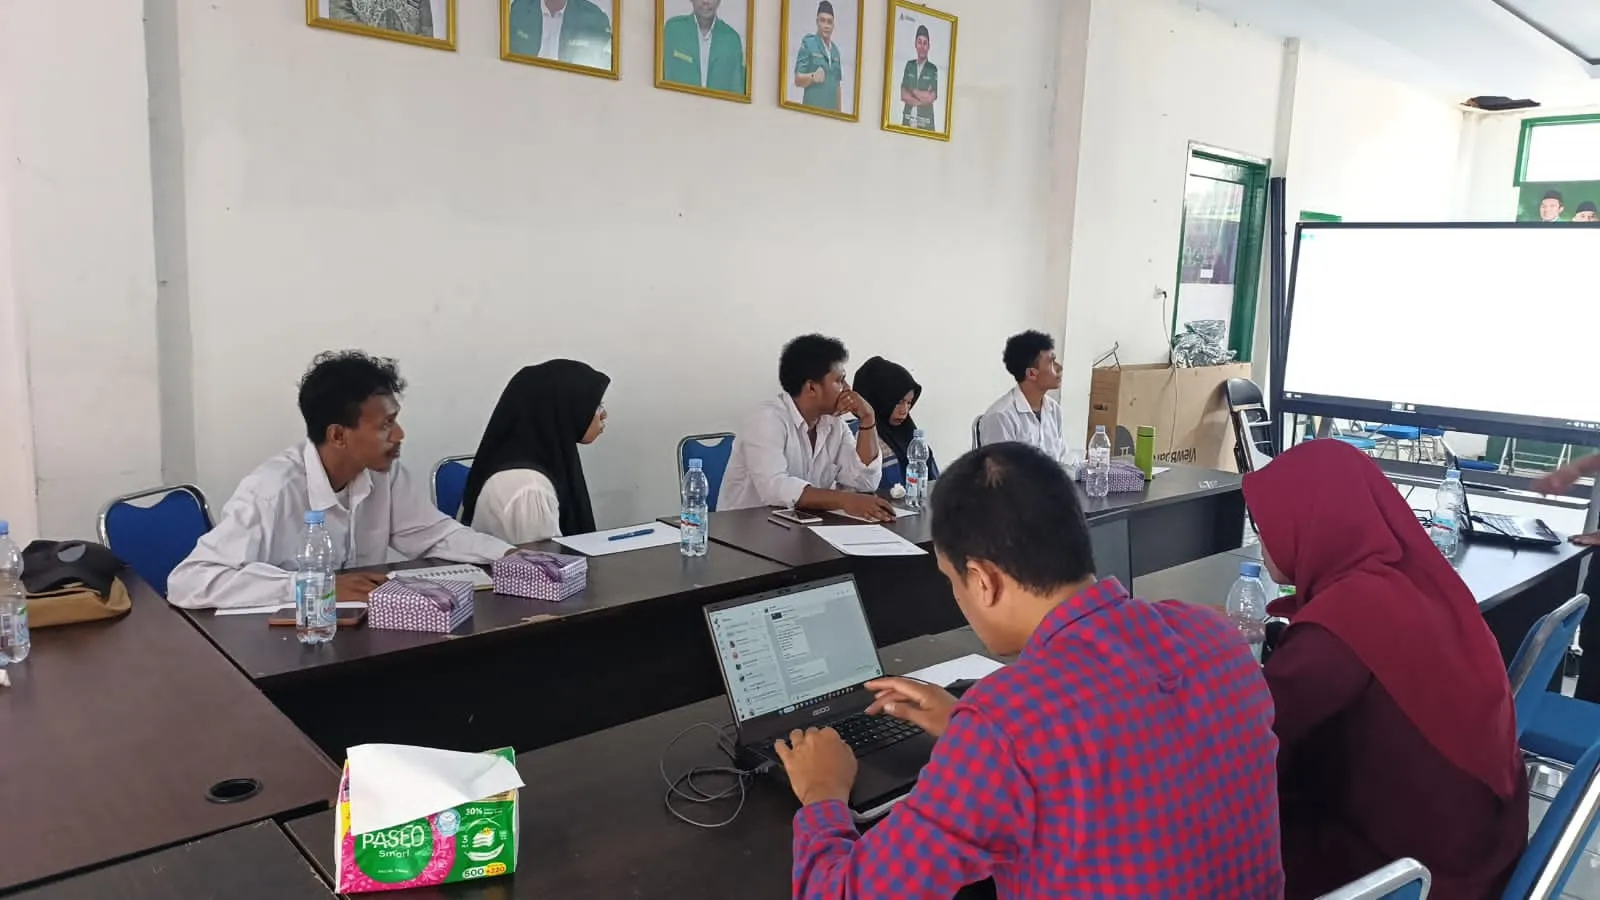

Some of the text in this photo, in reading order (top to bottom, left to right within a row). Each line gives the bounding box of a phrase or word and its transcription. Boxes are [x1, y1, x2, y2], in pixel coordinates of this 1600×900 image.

[1153, 448, 1197, 464] ViewBoar
[362, 824, 425, 849] PASEO
[379, 849, 410, 858] Smart
[464, 868, 484, 878] 500
